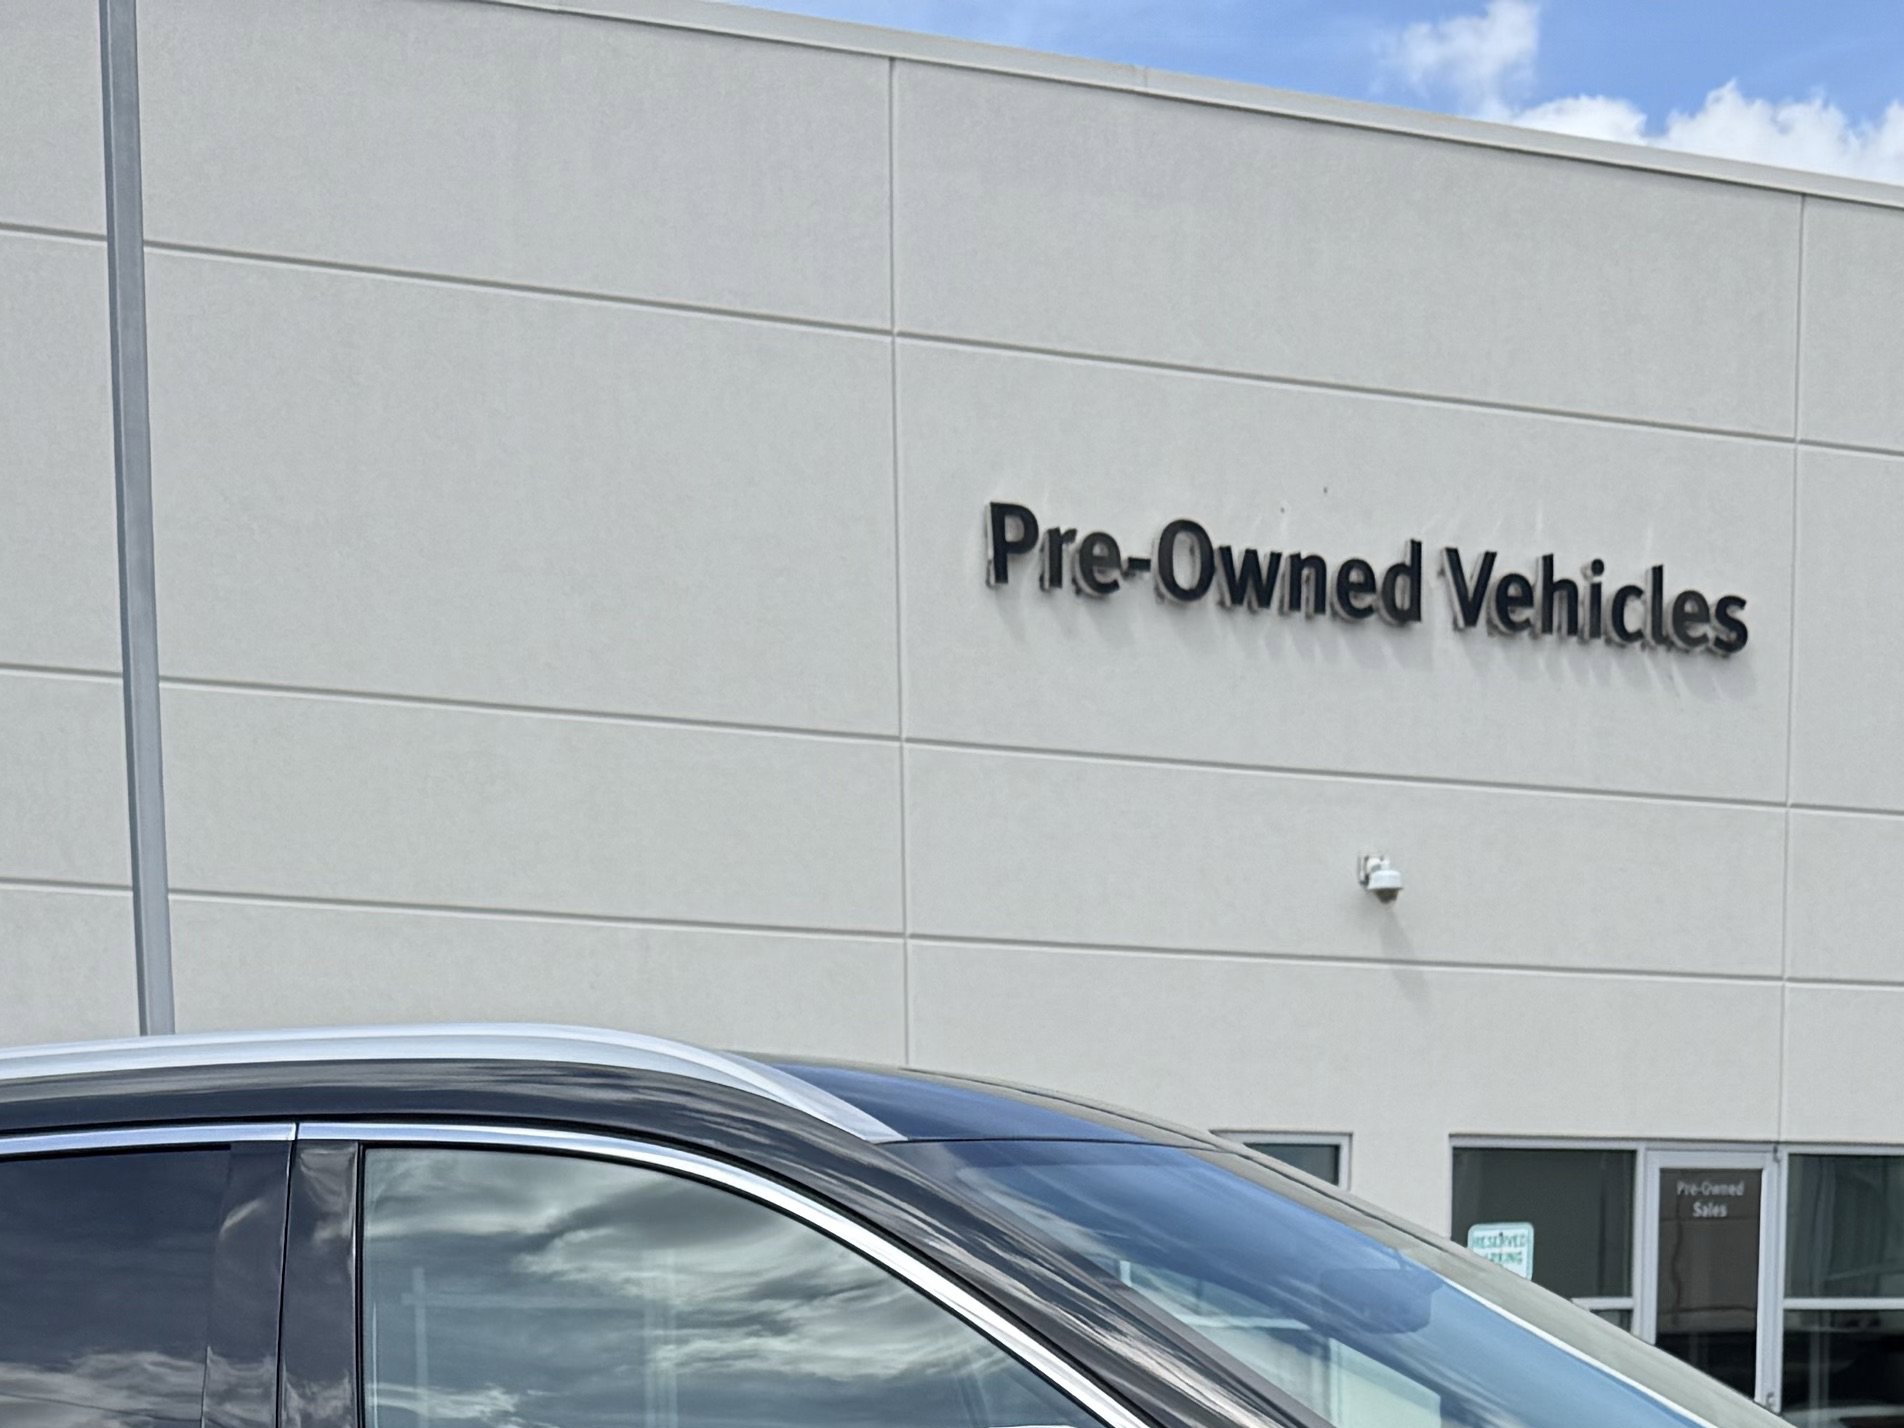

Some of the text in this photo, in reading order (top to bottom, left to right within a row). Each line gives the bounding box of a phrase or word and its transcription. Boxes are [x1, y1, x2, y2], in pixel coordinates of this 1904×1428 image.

[985, 502, 1749, 656] Pre-Owned Vehicles
[1676, 1181, 1745, 1196] Pre-Owned
[1693, 1201, 1728, 1217] Sales
